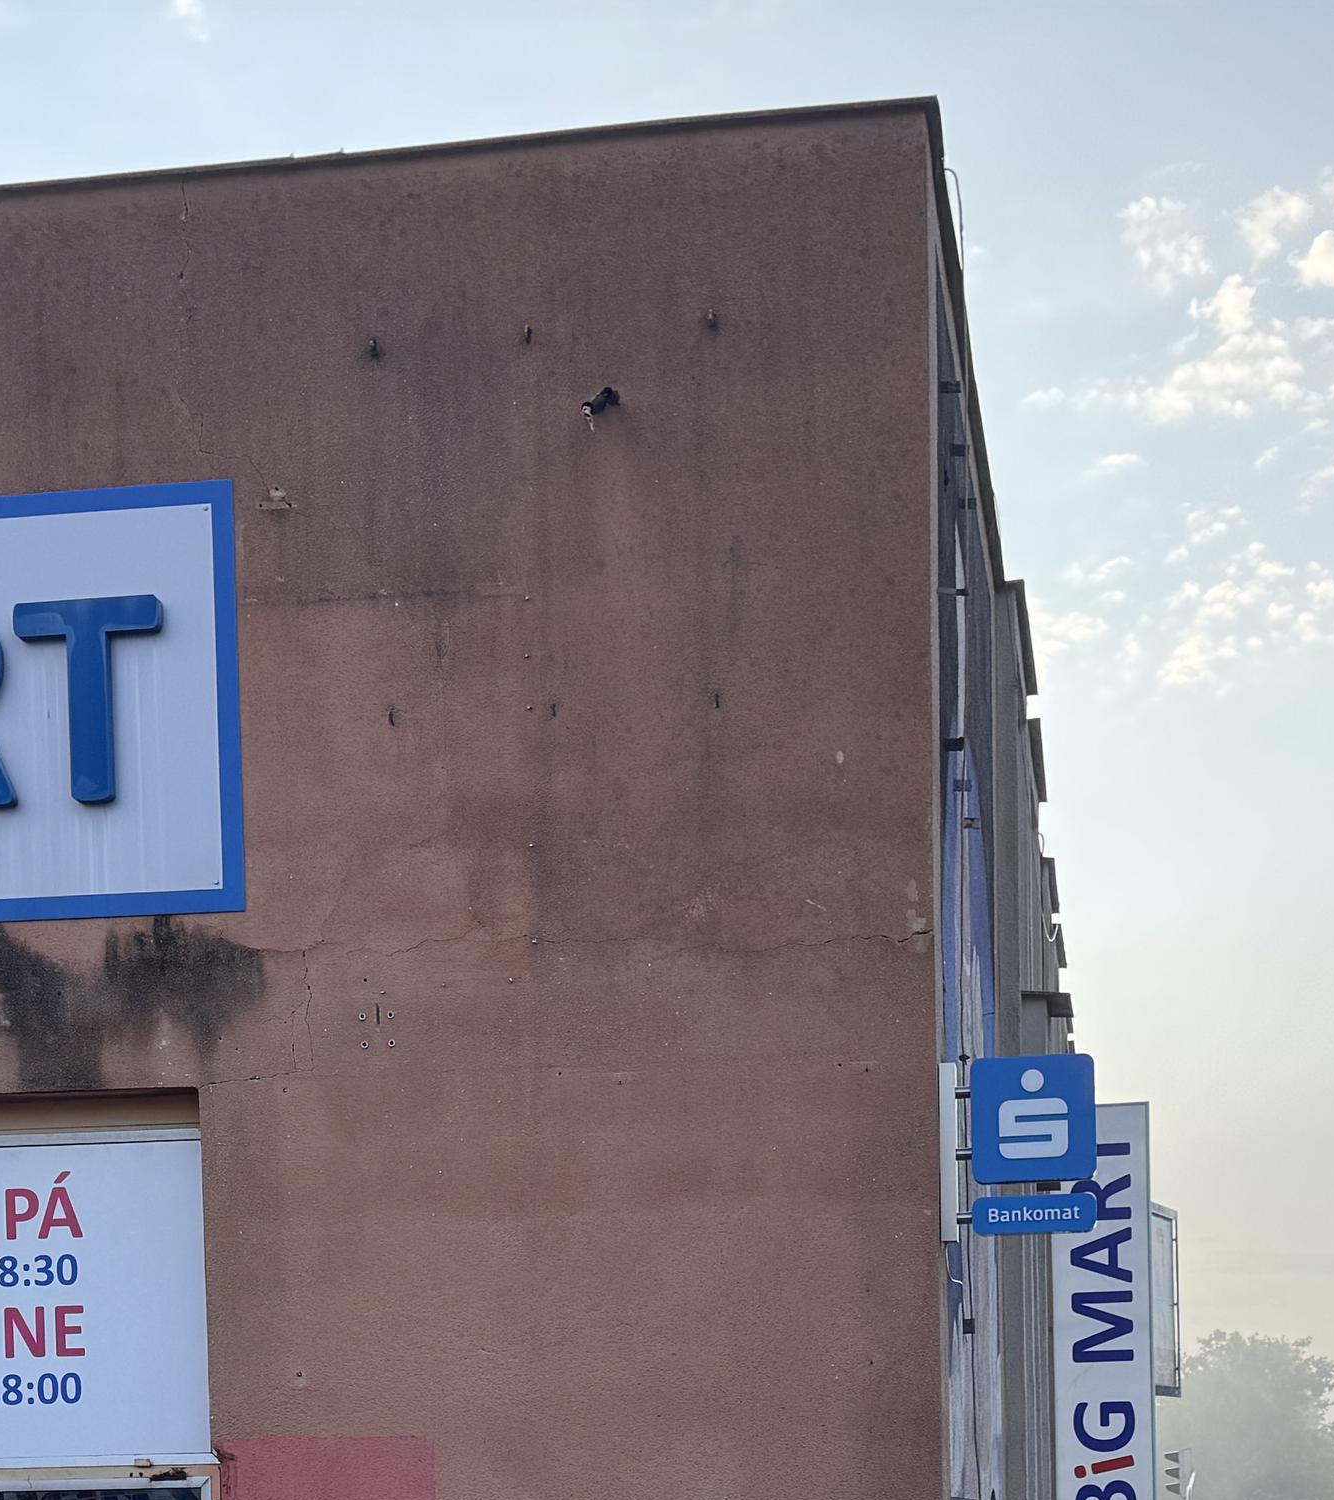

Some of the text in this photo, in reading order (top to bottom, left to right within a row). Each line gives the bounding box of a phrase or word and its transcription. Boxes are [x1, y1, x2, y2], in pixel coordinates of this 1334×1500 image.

[4, 1170, 84, 1241] PÁ
[988, 1206, 1080, 1223] Bankomat
[3, 1304, 87, 1359] NE
